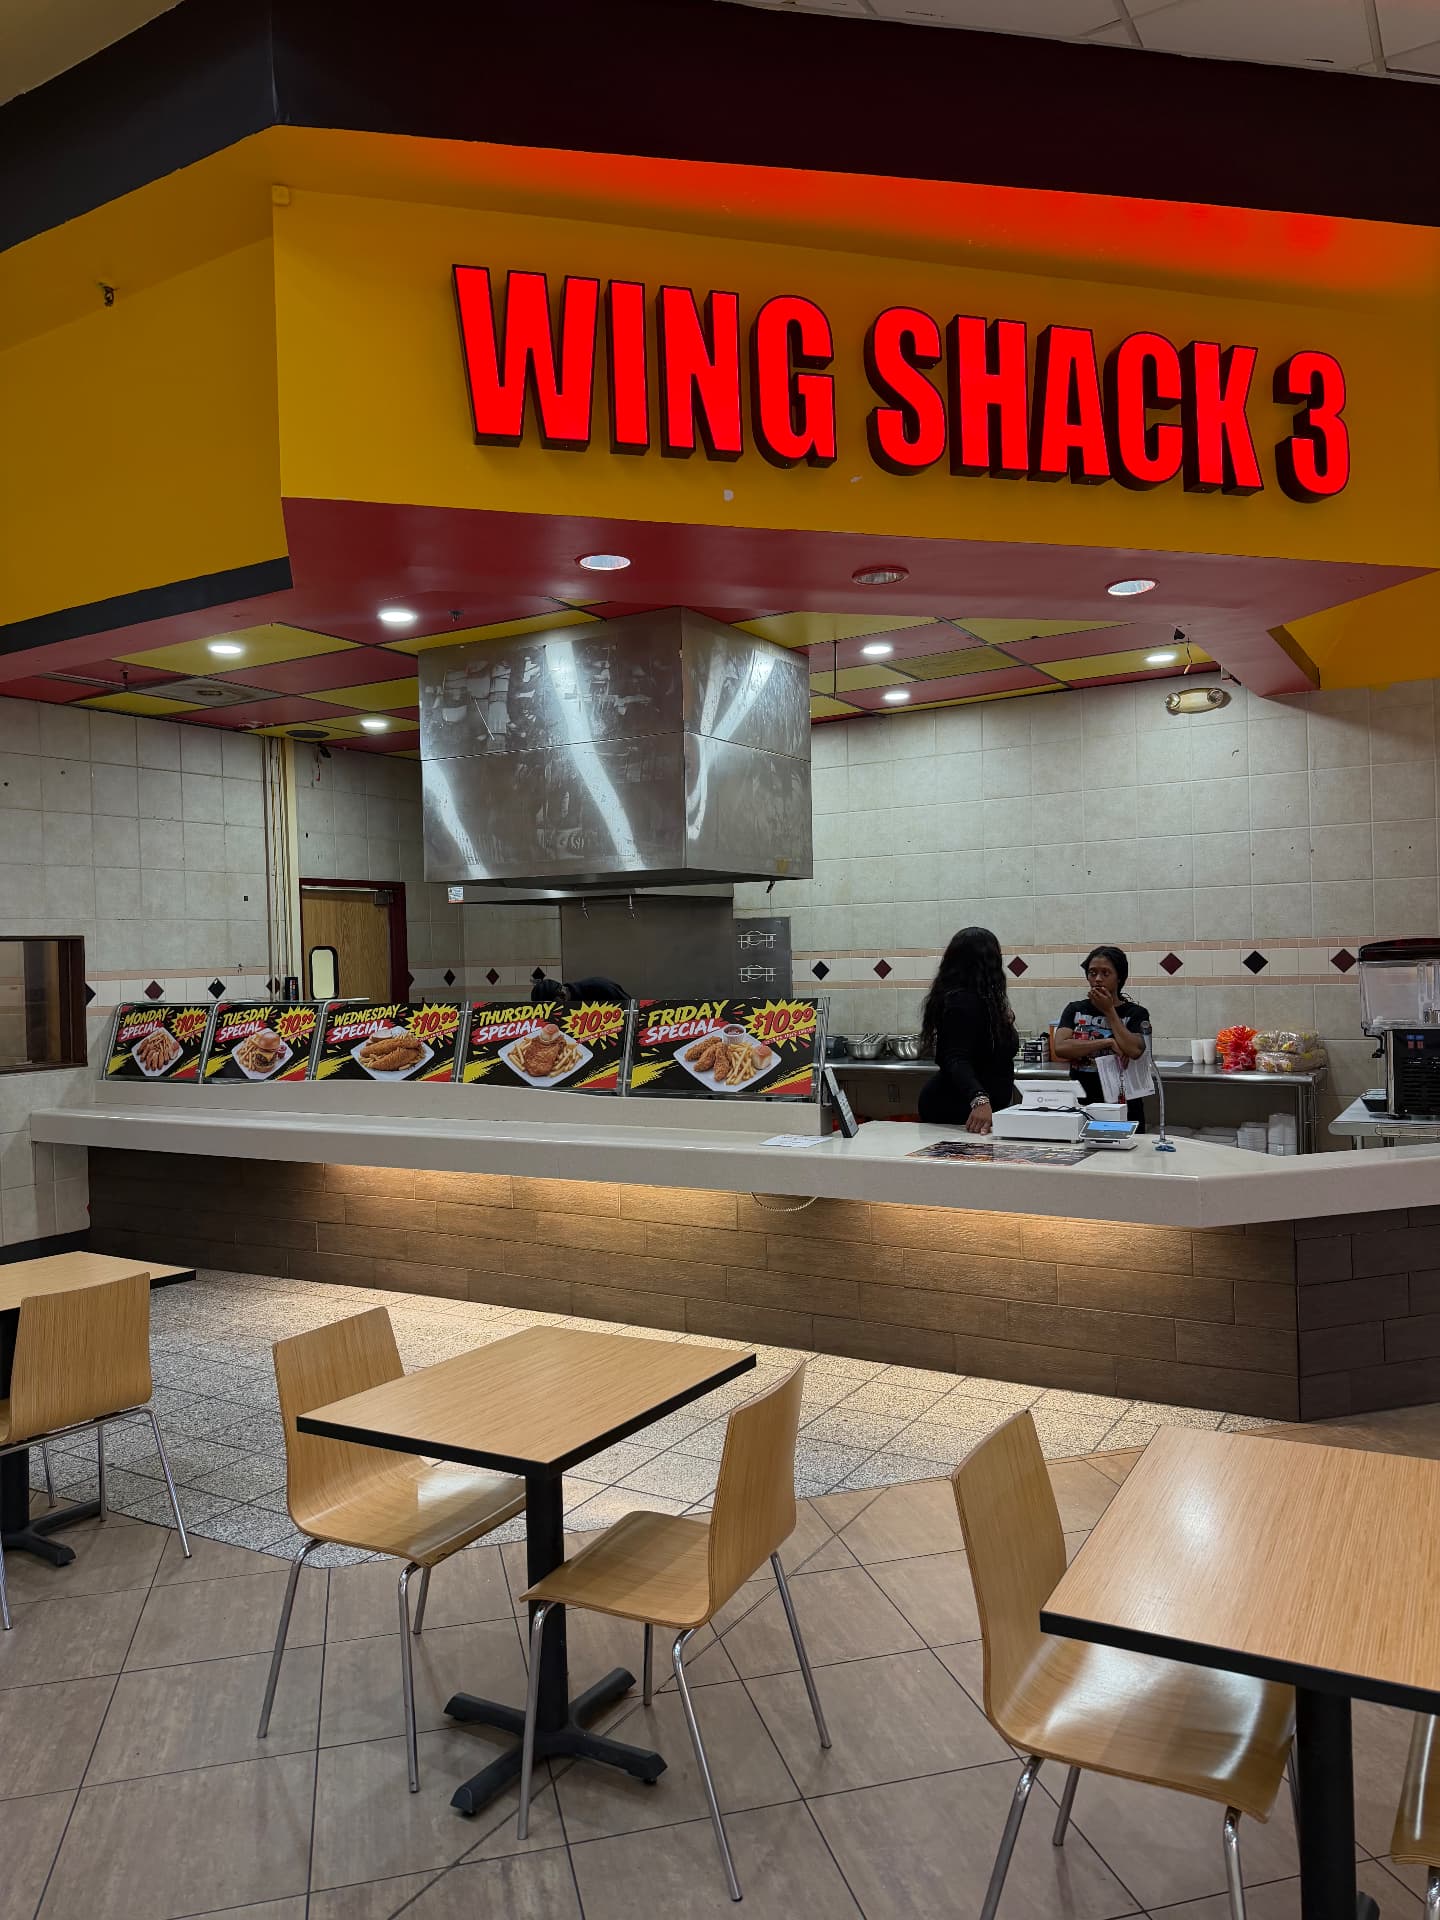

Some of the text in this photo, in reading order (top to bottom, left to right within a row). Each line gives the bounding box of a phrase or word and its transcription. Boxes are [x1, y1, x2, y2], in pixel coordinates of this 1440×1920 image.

[452, 264, 1350, 503] WING SHACK 3
[123, 1007, 170, 1027] MONDAY
[222, 1006, 273, 1027] TUESDAY
[279, 1013, 315, 1033] $10.99
[333, 1004, 400, 1027] WEDNESDAY
[411, 1010, 458, 1034] $10.99
[479, 1001, 556, 1026] THURSDAY
[569, 1008, 622, 1034] $10.99
[647, 999, 730, 1028] FRIDAY
[752, 1007, 815, 1035] $10.99
[121, 1021, 161, 1040] SPECIAL
[218, 1021, 262, 1041] SPECIAL
[331, 1020, 389, 1042] SPECIAL
[477, 1018, 543, 1042] SPECIAL
[645, 1018, 721, 1044] SPECIAL
